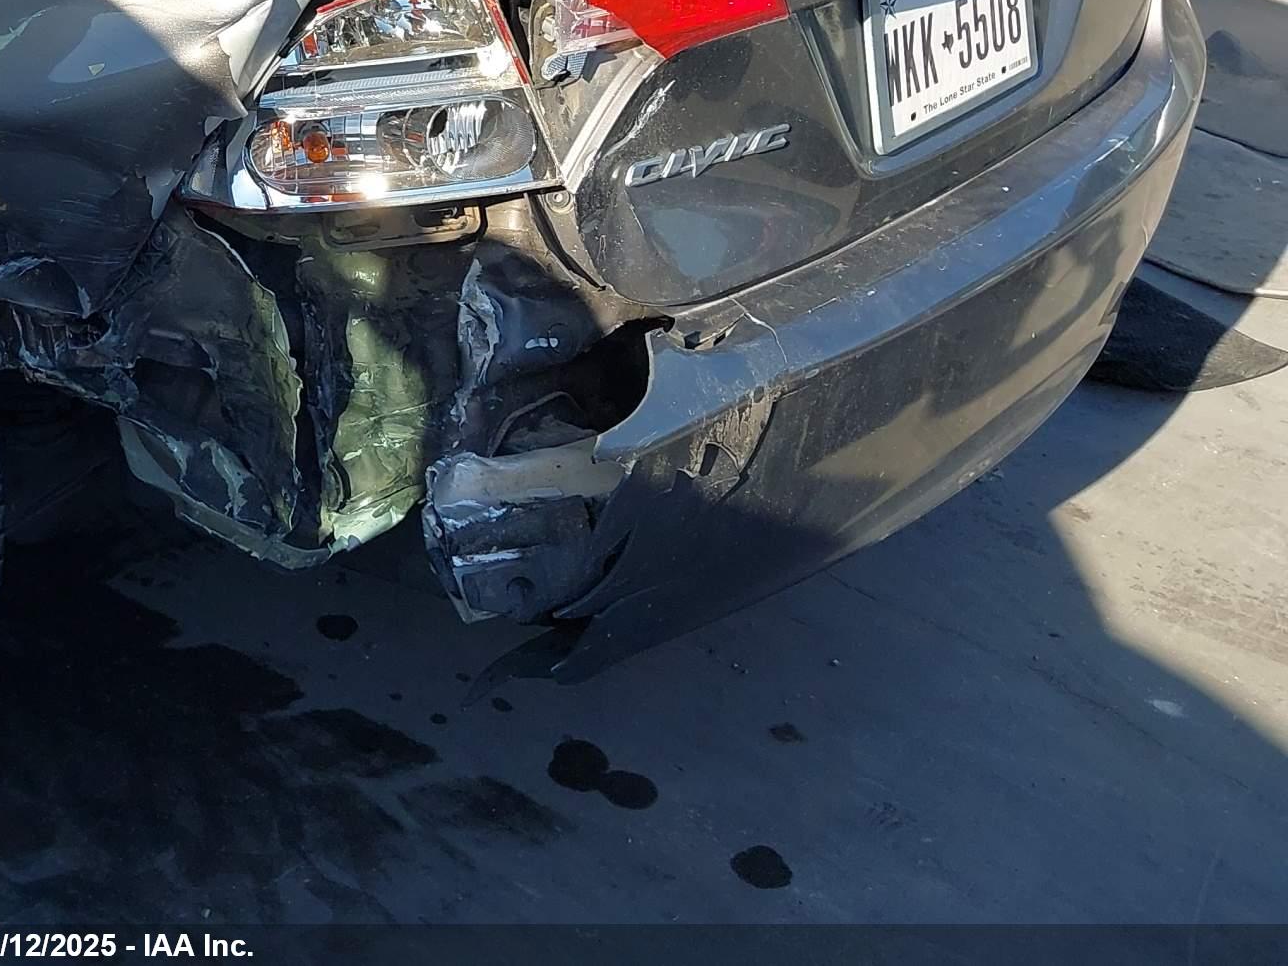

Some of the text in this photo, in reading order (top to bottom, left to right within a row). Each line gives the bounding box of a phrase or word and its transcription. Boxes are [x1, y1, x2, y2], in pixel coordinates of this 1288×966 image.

[883, 12, 939, 107] WKK
[923, 72, 996, 114] The Lone Star State
[624, 123, 792, 187] CIVIC
